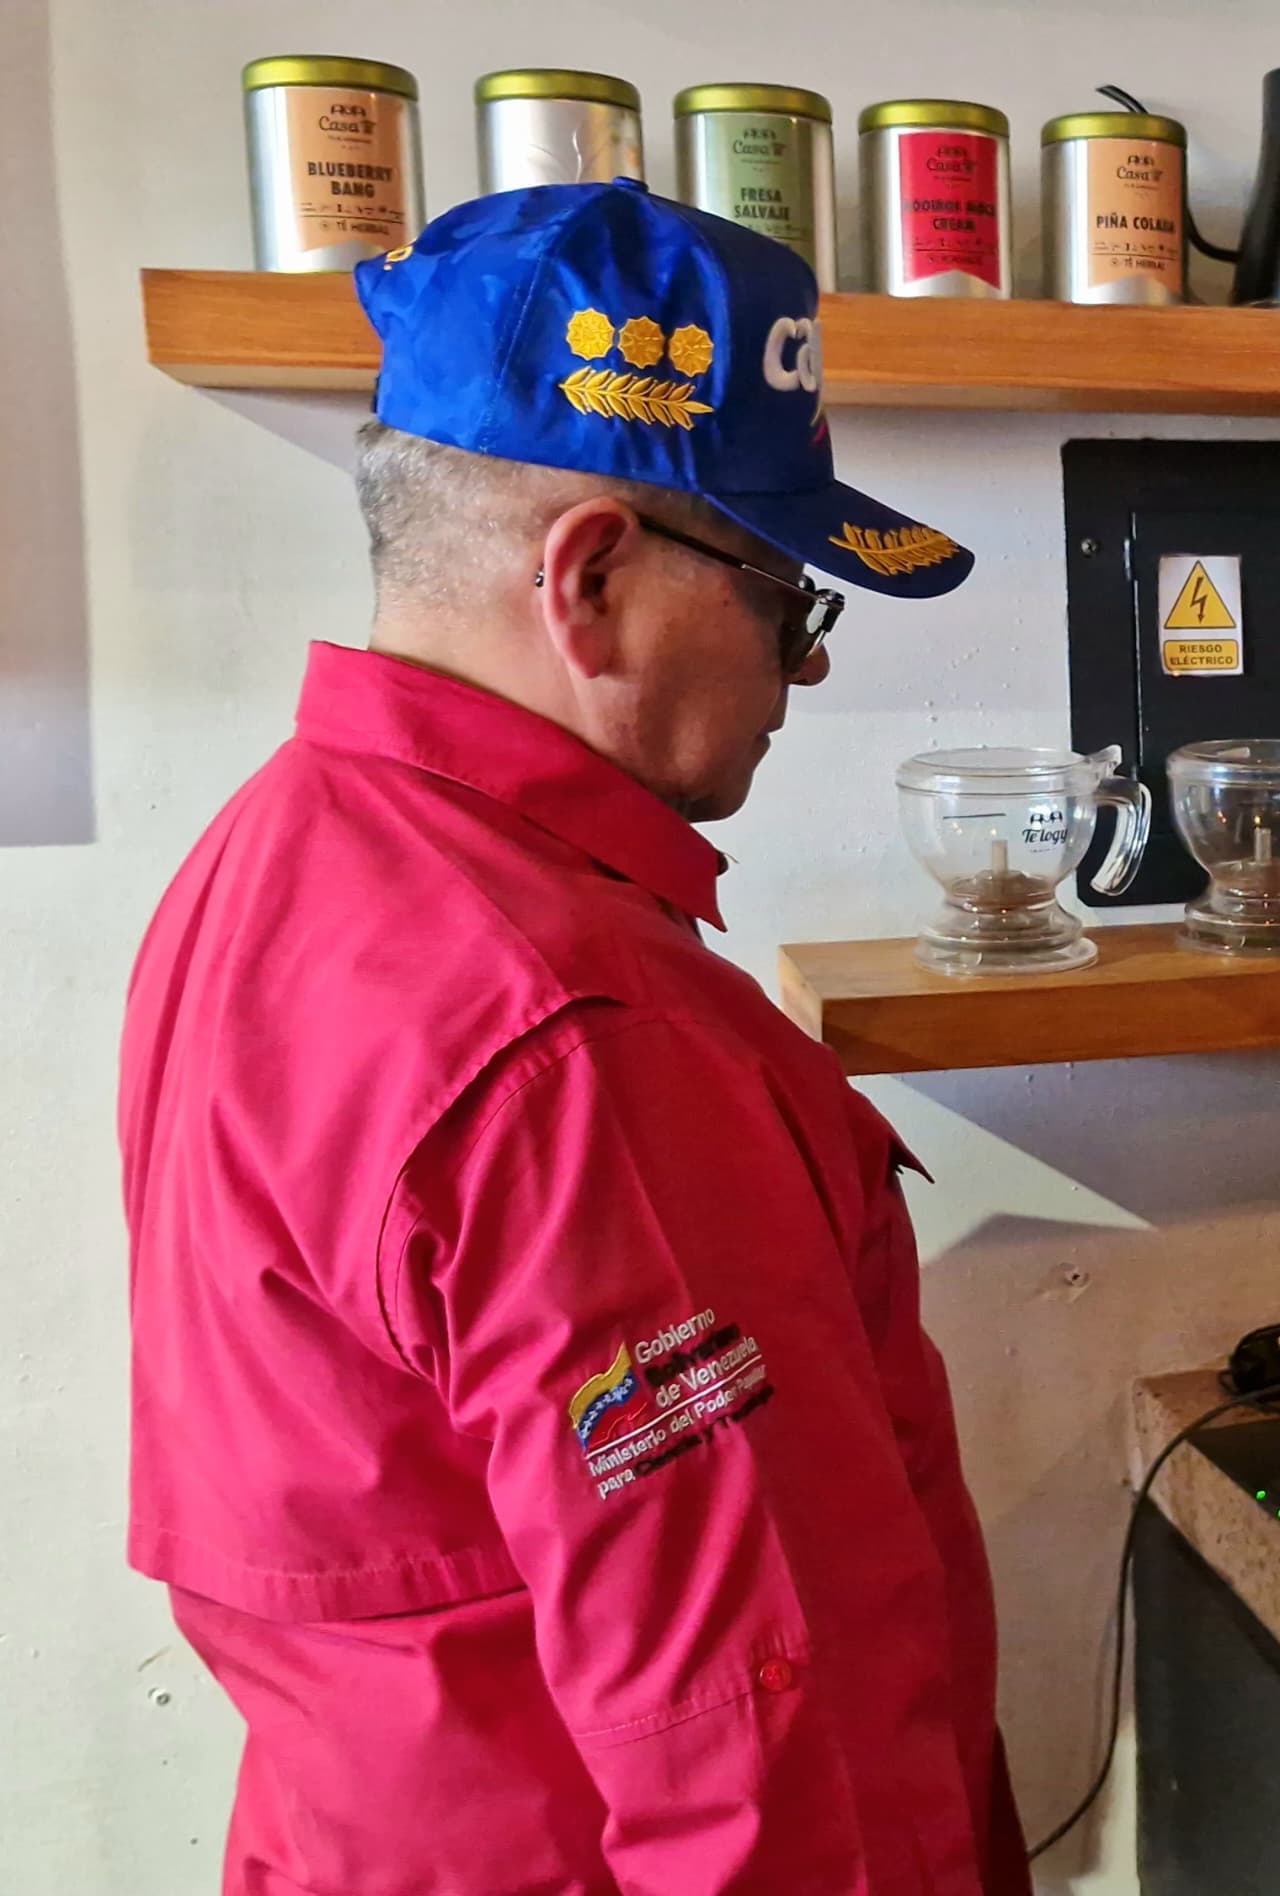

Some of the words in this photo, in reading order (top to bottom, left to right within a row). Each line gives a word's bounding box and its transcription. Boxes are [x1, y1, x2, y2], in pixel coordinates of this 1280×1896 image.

[307, 161, 393, 182] BLUEBERRY
[330, 181, 375, 198] BANG
[740, 187, 783, 203] FRESA
[734, 205, 790, 221] SALVAJE
[1096, 211, 1128, 229] PIÑA
[1133, 216, 1175, 233] COLADA
[1178, 643, 1223, 654] RIESGO
[1169, 654, 1234, 666] ELÉCTRICO
[634, 1308, 716, 1364] Gobierno
[655, 1379, 681, 1409] de
[680, 1336, 759, 1392] Venezuela
[588, 1427, 667, 1478] Ministerio
[669, 1411, 695, 1434] del
[694, 1387, 737, 1419] Poder
[597, 1467, 636, 1501] para
